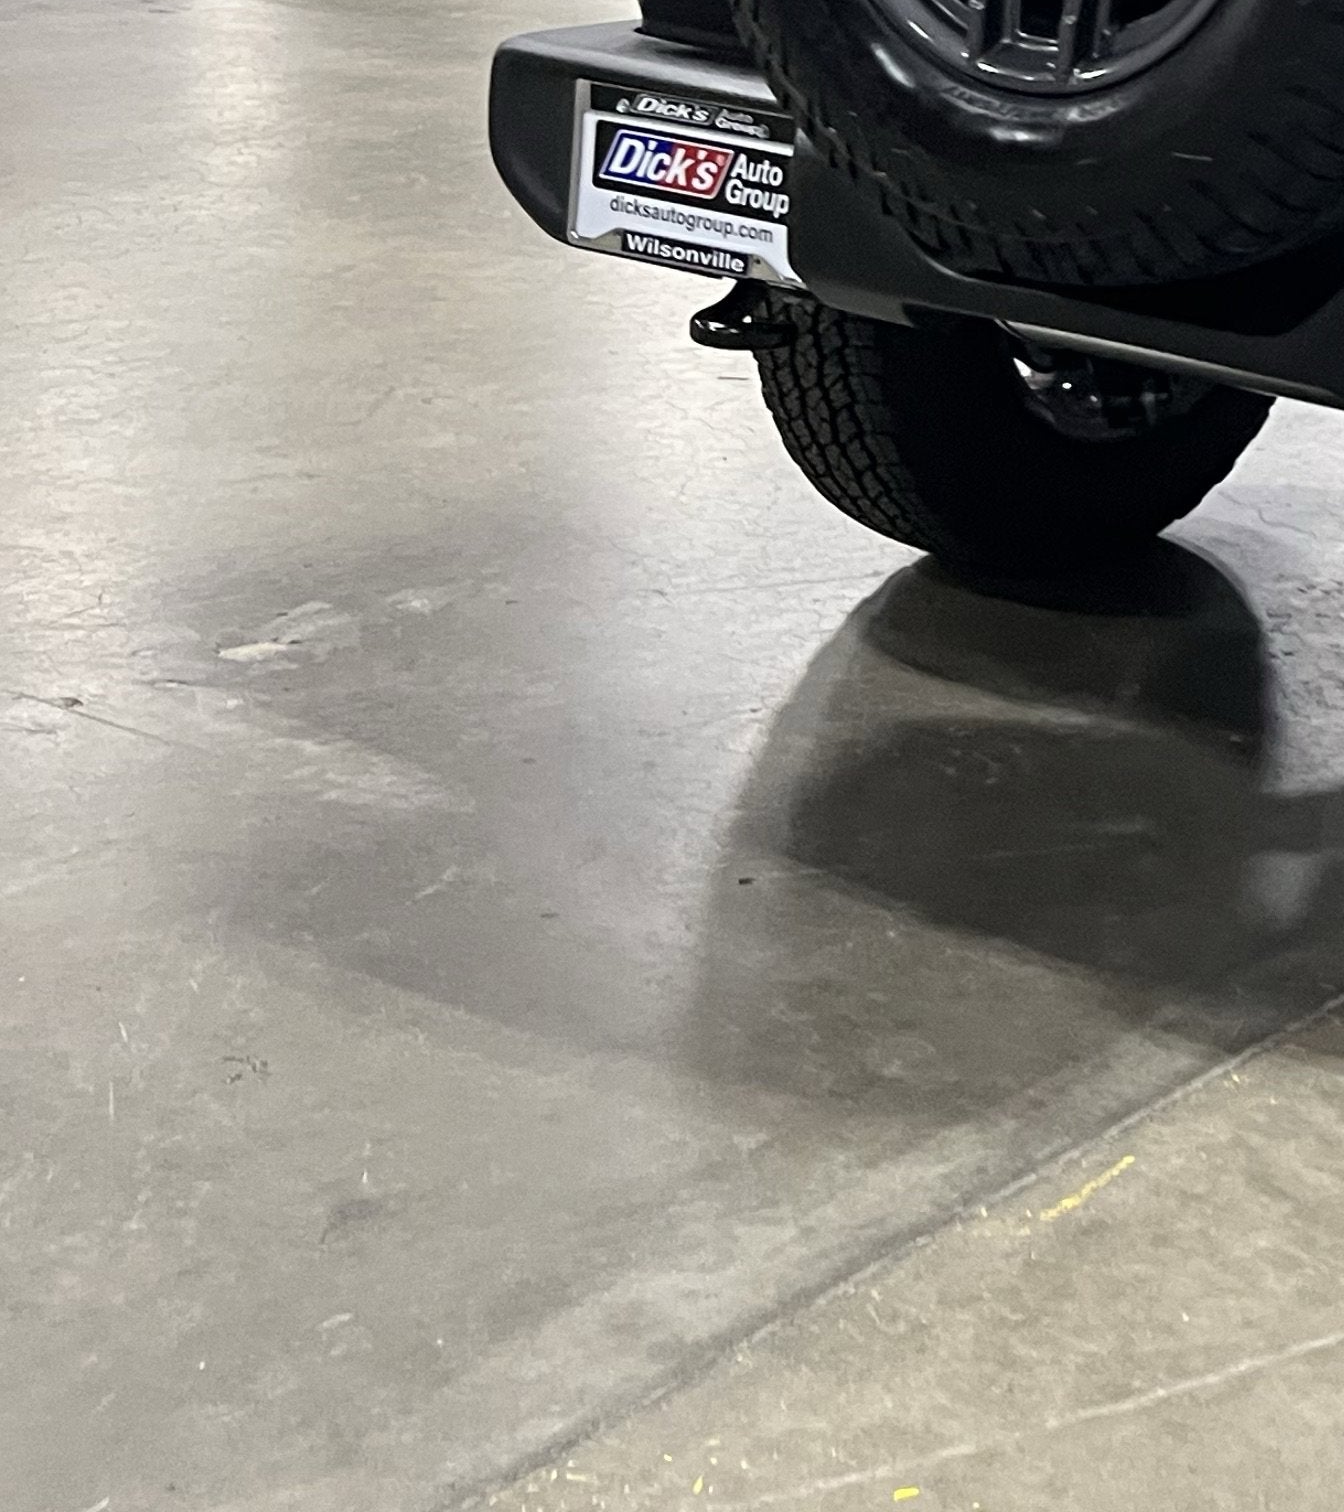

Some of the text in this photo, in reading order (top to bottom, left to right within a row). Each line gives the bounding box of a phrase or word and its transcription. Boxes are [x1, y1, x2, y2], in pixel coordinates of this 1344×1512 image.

[637, 97, 710, 123] Dick's
[608, 137, 719, 192] Dick's
[731, 153, 784, 187] Auto
[725, 179, 790, 218] Group
[609, 195, 774, 243] dicksautogroup.com
[626, 233, 745, 272] Wilsonville
